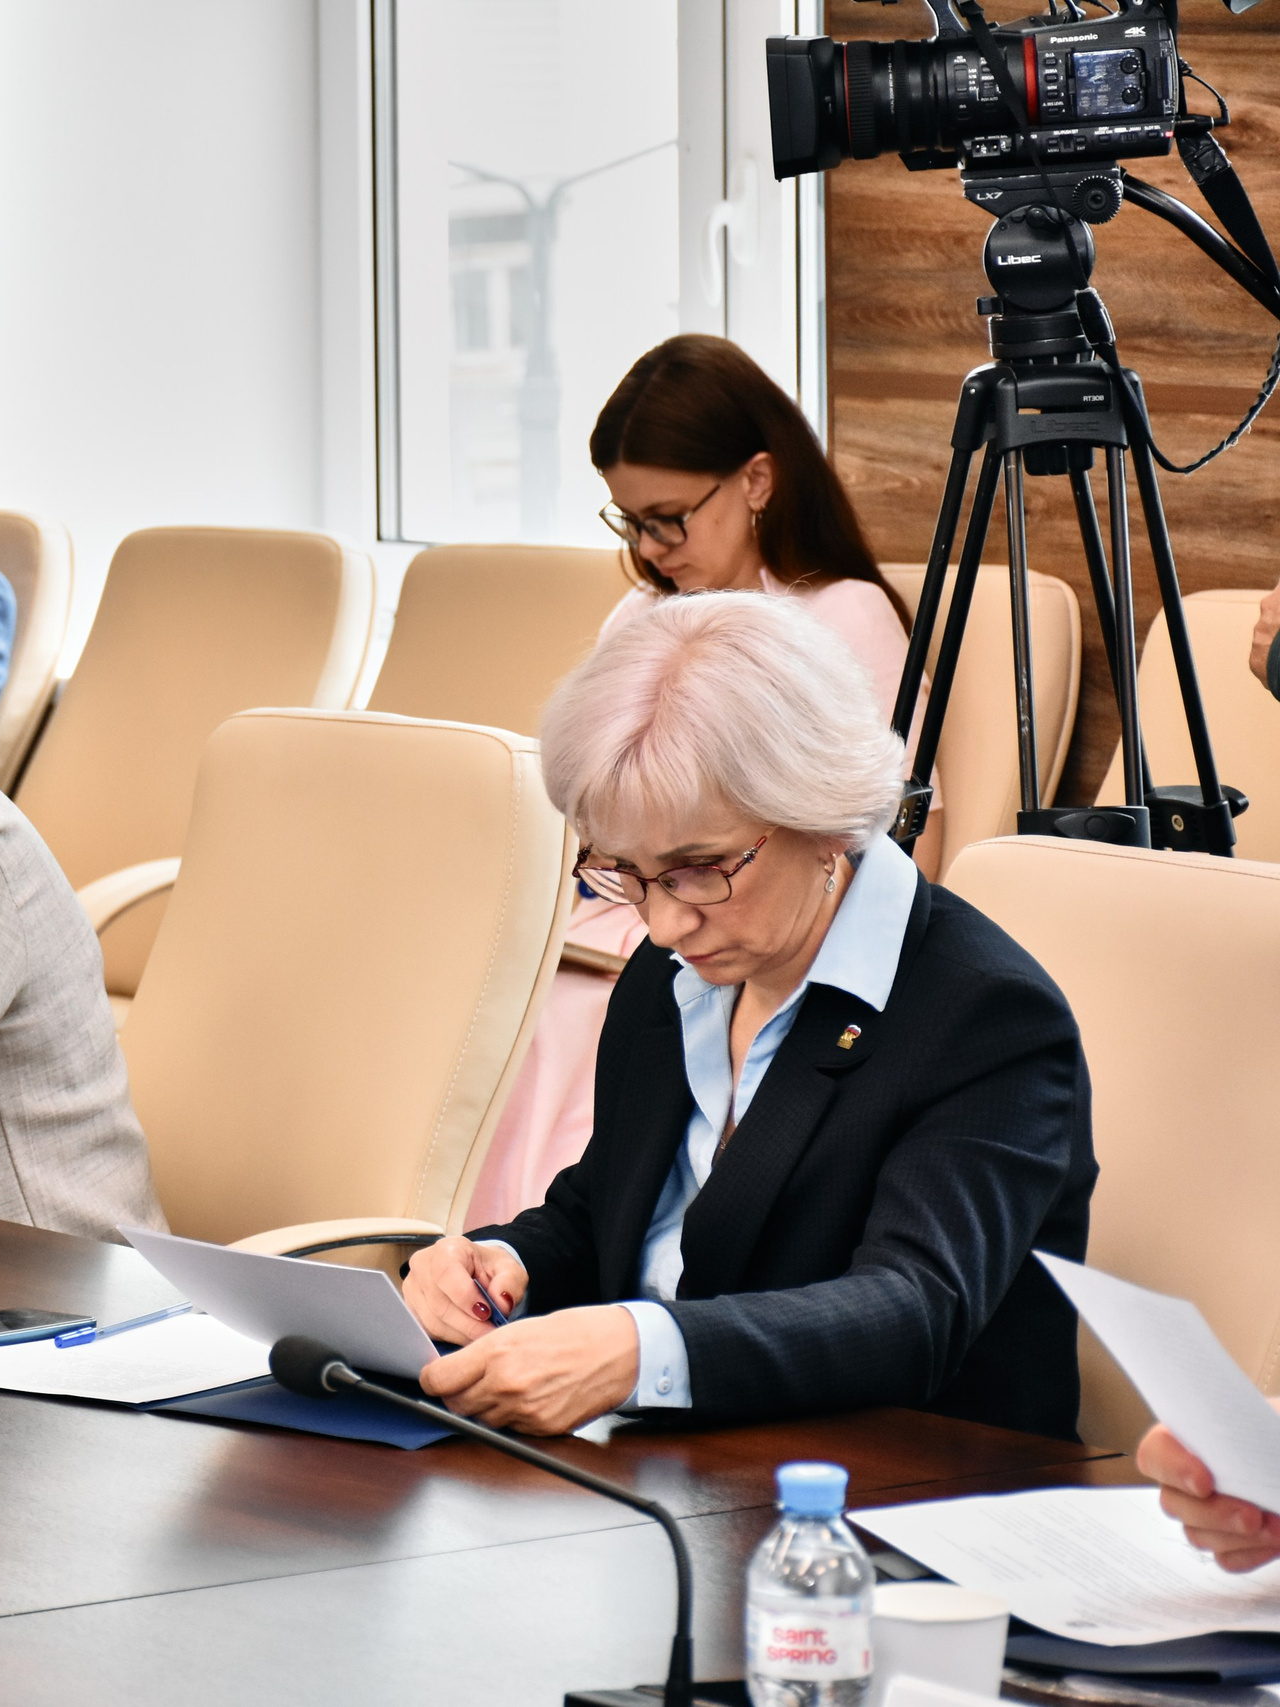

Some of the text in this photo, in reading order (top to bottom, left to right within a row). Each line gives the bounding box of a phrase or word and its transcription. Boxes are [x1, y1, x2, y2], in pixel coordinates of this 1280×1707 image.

[1125, 26, 1146, 35] 4K
[1050, 33, 1099, 44] Panasonic
[976, 191, 1004, 200] LX7
[997, 254, 1042, 266] Libec
